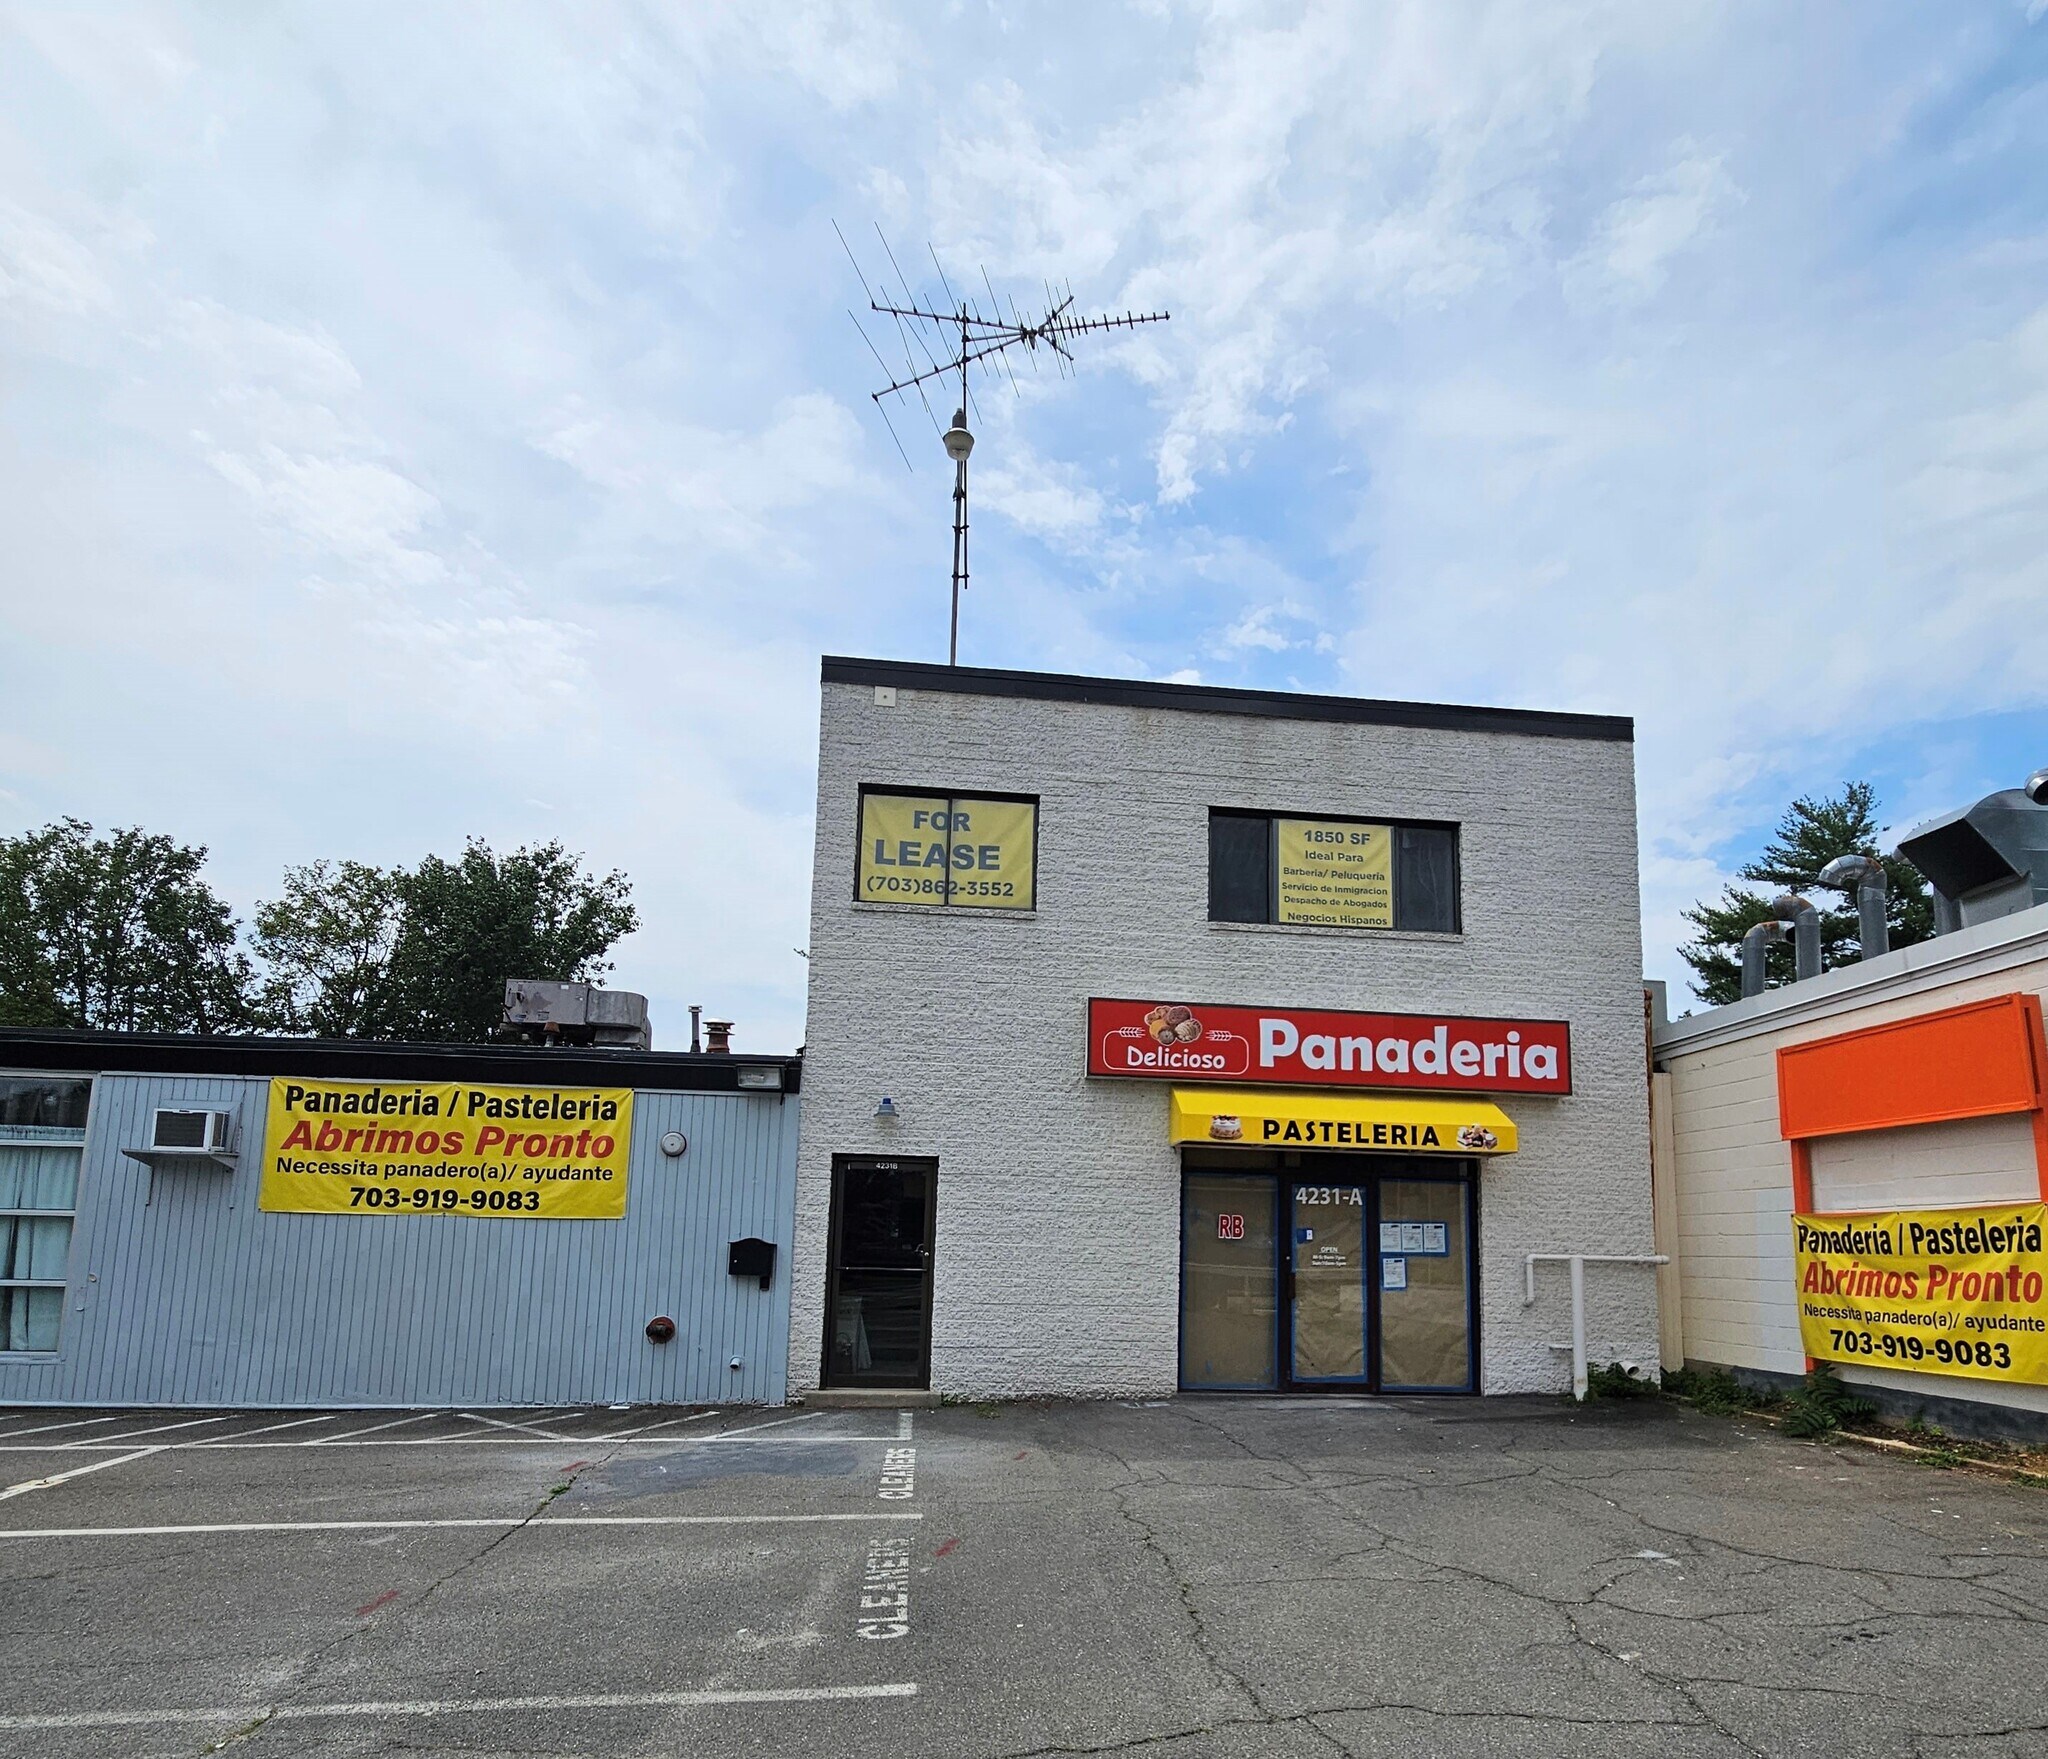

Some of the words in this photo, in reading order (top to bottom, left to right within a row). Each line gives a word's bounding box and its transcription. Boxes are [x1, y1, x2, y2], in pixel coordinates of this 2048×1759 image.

[913, 810, 971, 832] FOR
[1304, 830, 1344, 844] 1850
[1350, 833, 1371, 845] SF
[875, 839, 1000, 871] LEASE
[1305, 850, 1334, 861] Ideal
[1337, 853, 1364, 862] Para
[866, 876, 1014, 897] (703)862-3552
[1282, 882, 1318, 892] Servicio
[1320, 885, 1332, 893] de
[1284, 896, 1327, 905] Despacho
[1343, 899, 1387, 909] Abogados
[1287, 912, 1337, 924] Negocios
[1340, 915, 1388, 926] Hispanos
[1126, 1044, 1226, 1070] Delicioso
[1259, 1018, 1558, 1080] Panaderia
[285, 1085, 439, 1117] Panaderia
[446, 1091, 460, 1118] /
[467, 1091, 618, 1121] Pasteleria
[280, 1120, 465, 1156] Abrimos
[474, 1126, 616, 1160] Pronto
[1262, 1119, 1441, 1148] PASTELERIA
[276, 1157, 379, 1177] Necessita
[383, 1158, 518, 1183] panadero(a)/
[522, 1164, 613, 1183] ayudante
[350, 1187, 541, 1211] 703-919-9083
[1295, 1187, 1363, 1206] 4231-A
[1218, 1214, 1245, 1239] RB
[1797, 1222, 1893, 1255] Panaderia
[1909, 1216, 2042, 1255] Pasteleria
[1803, 1260, 1919, 1300] Abrimos
[1926, 1264, 2043, 1303] Pronto
[1804, 1303, 1862, 1321] Necessita
[1865, 1310, 1960, 1331] panadero(a)/
[1964, 1313, 2046, 1332] ayudante
[1830, 1329, 2012, 1369] 703-919-9083
